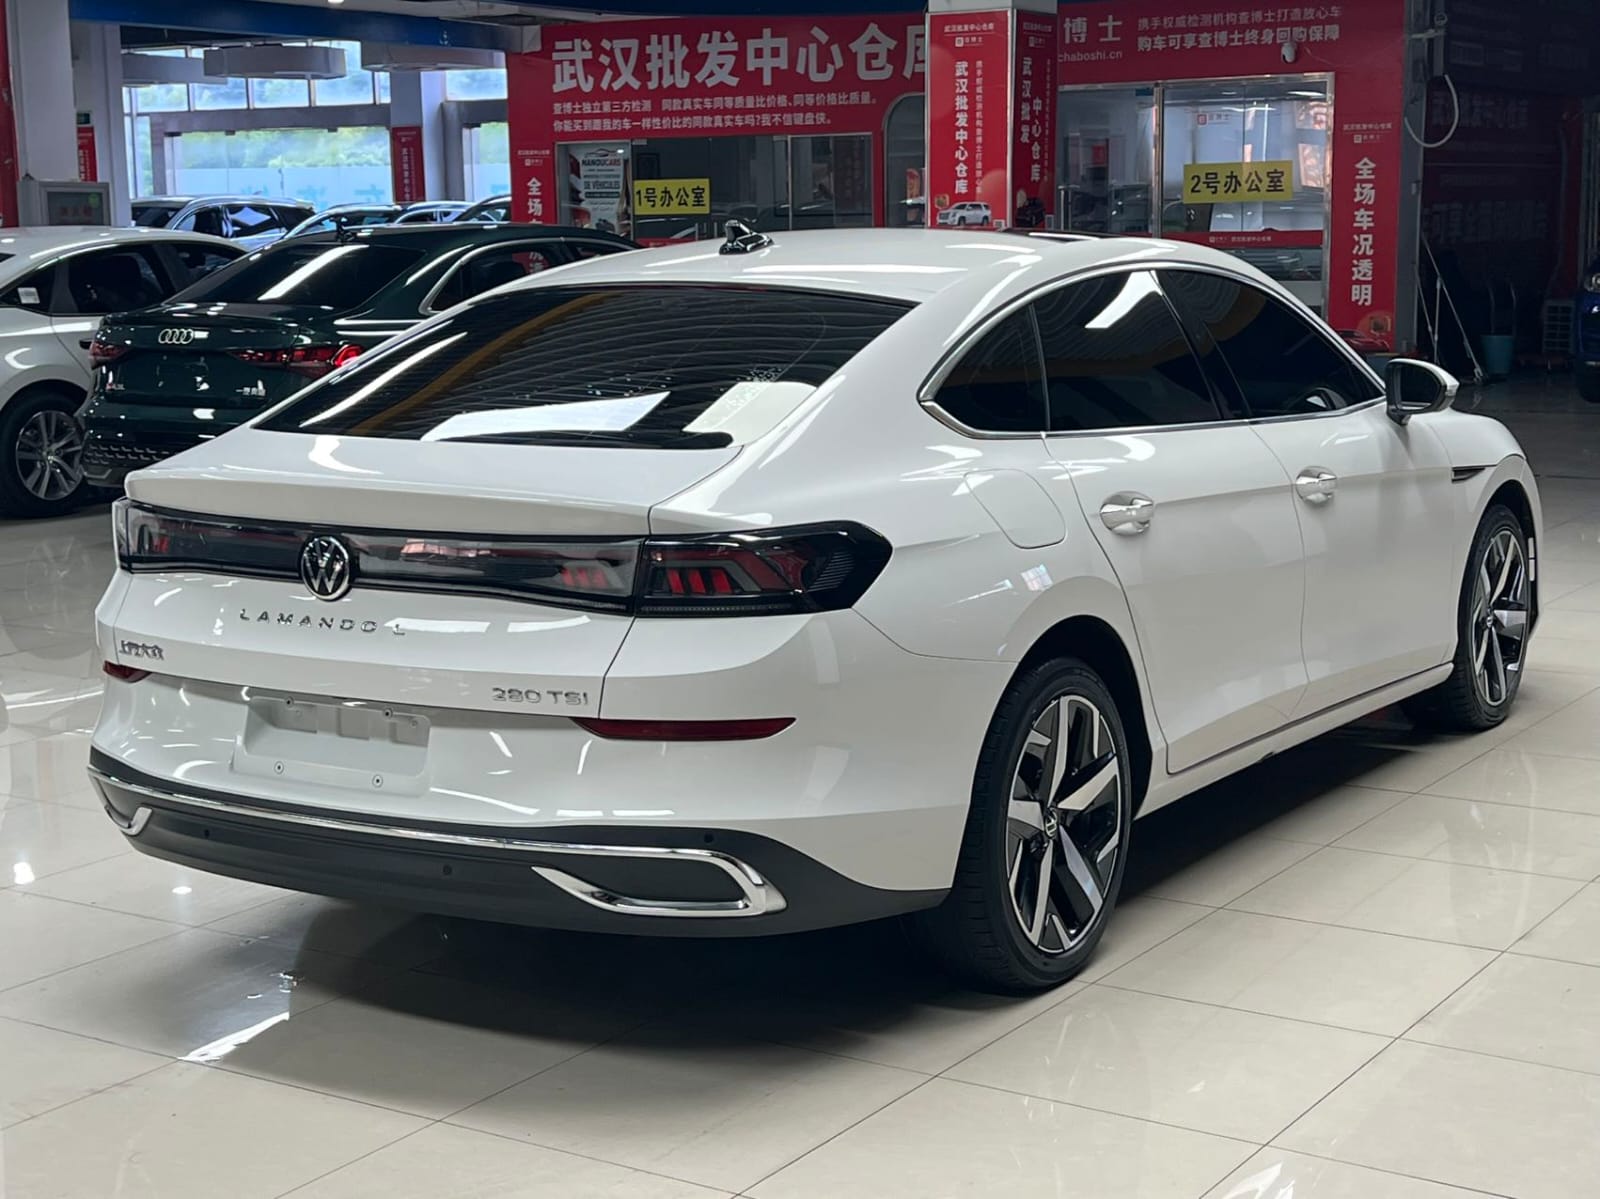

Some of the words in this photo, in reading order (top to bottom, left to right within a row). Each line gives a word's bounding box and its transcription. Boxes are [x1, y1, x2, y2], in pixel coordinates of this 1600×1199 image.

[955, 61, 968, 194] 武汉批发中心仓库
[1031, 97, 1042, 182] 中心仓库
[635, 185, 706, 208] 1号办公室
[1190, 169, 1285, 194] 2号办公室
[527, 177, 543, 224] 全场
[1351, 157, 1376, 306] 全场车况透明
[240, 608, 377, 633] LAMANDO
[546, 690, 588, 706] TSI
